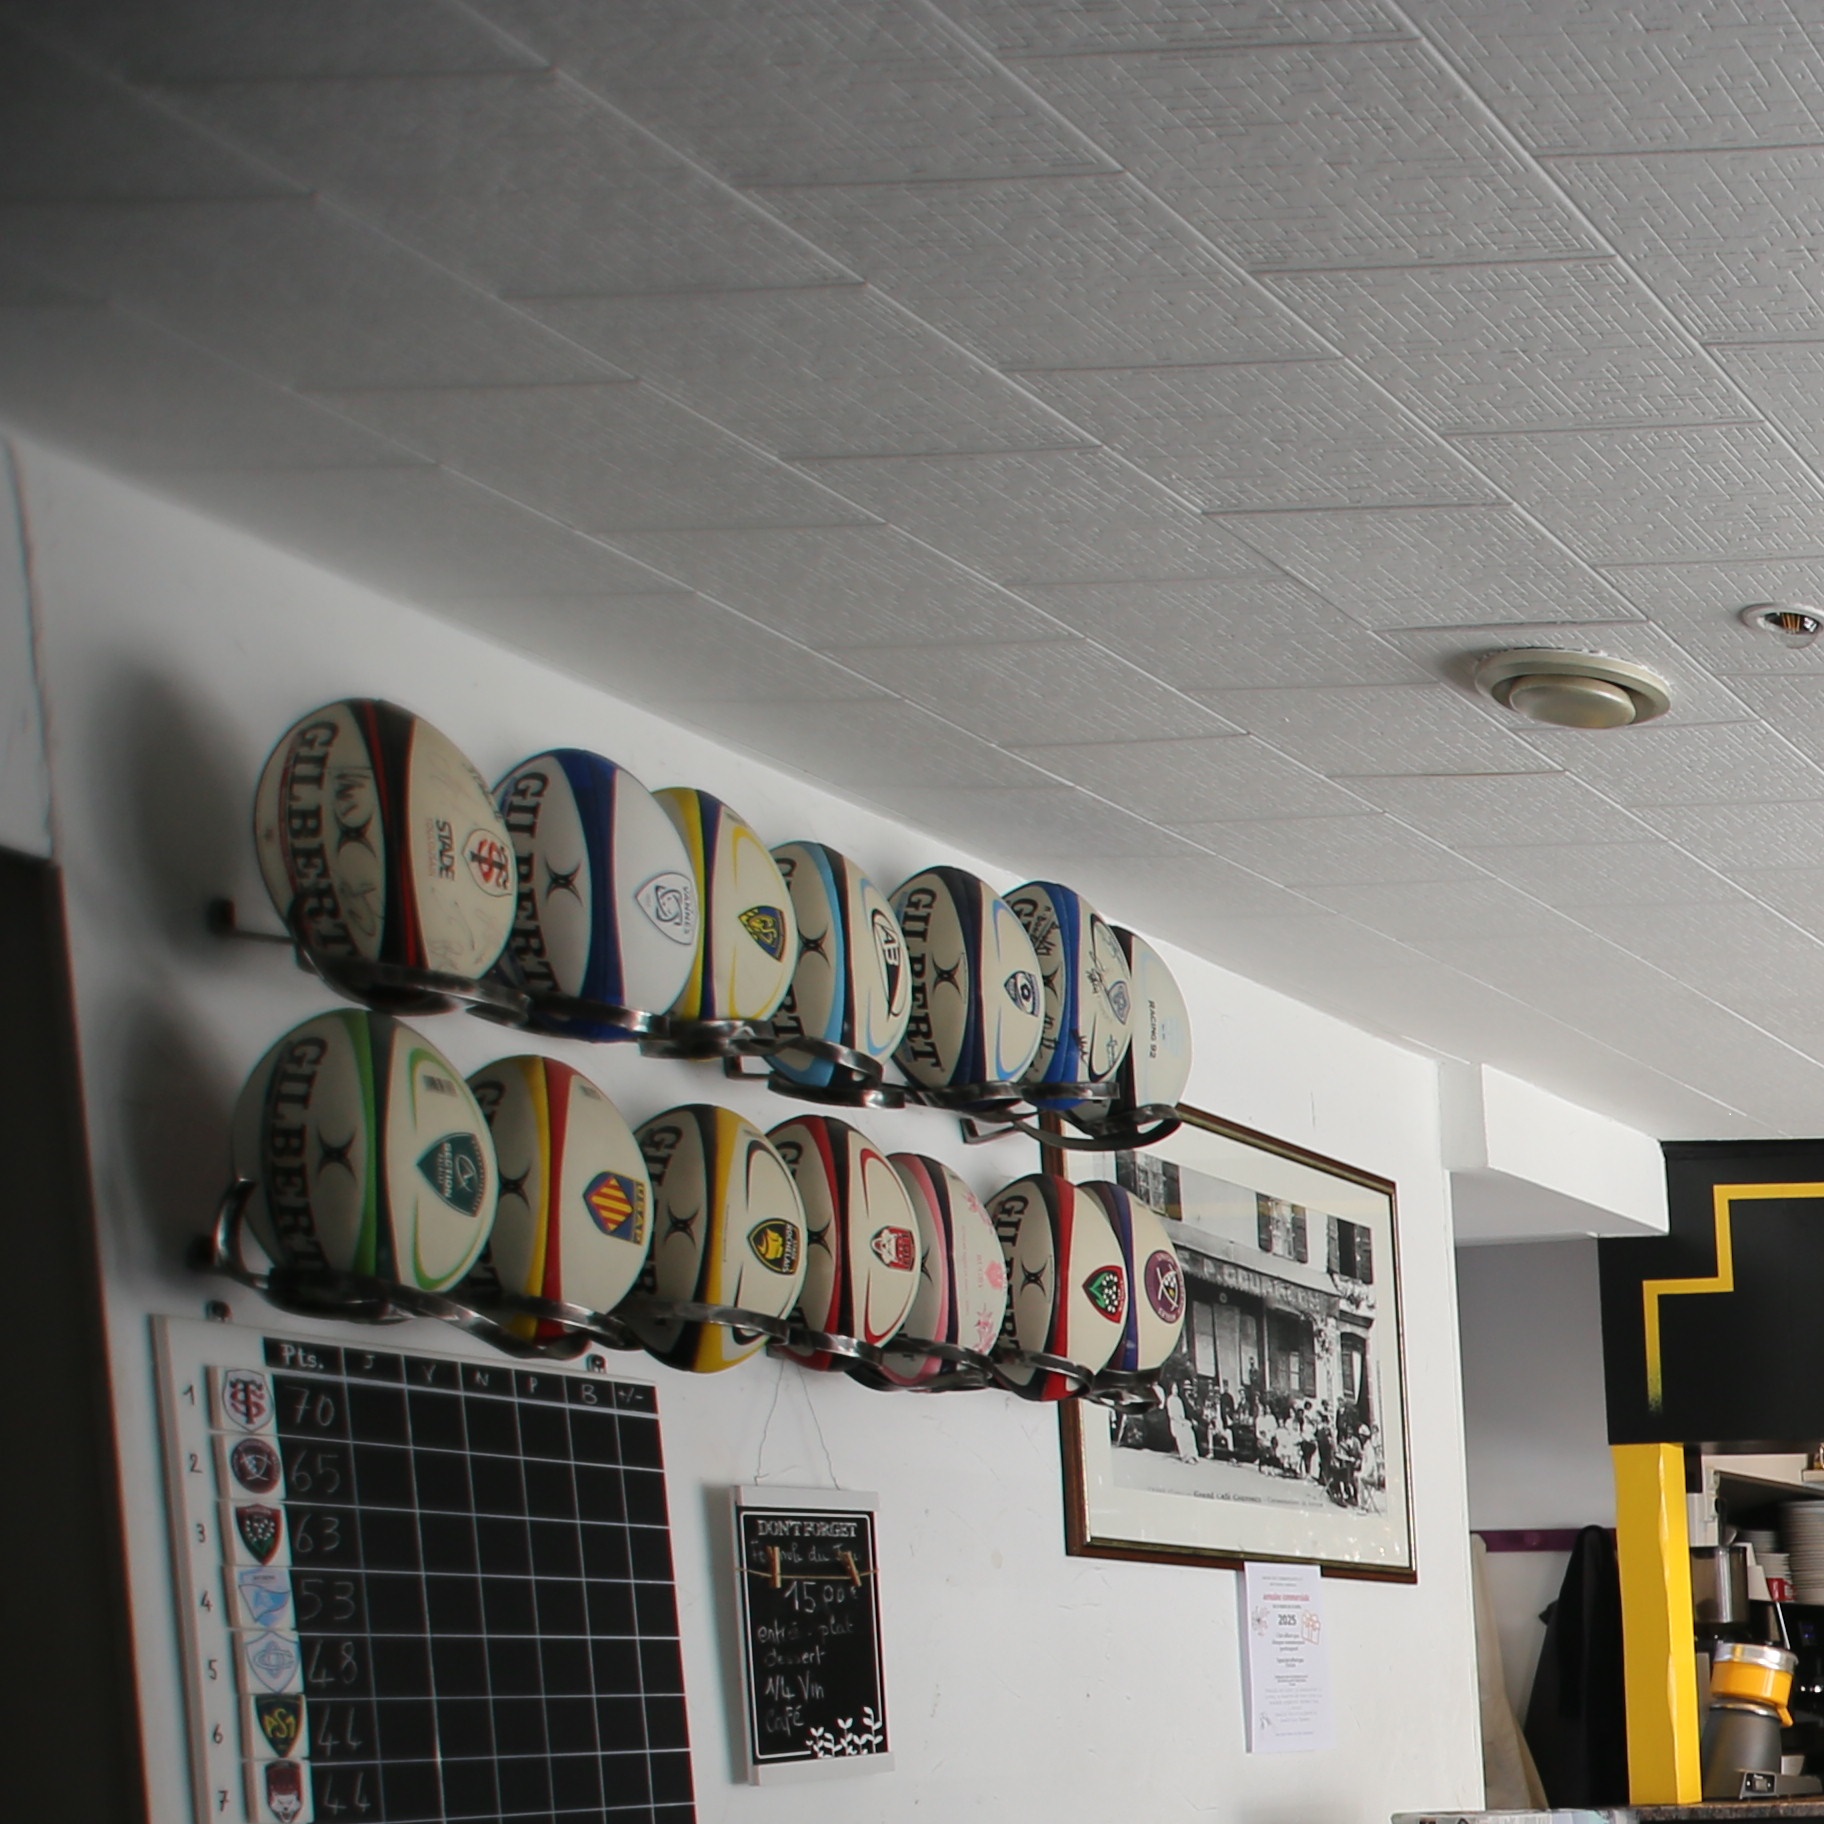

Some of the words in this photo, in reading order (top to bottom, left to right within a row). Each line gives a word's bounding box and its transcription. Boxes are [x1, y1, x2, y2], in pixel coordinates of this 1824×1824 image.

[436, 819, 456, 881] STADE
[1148, 1000, 1158, 1046] RACING
[1149, 1045, 1158, 1059] 92
[443, 1141, 454, 1198] SECTION
[281, 1343, 324, 1370] Pts.
[474, 1371, 490, 1388] N
[580, 1383, 599, 1405] B
[285, 1384, 336, 1428] 70
[188, 1453, 203, 1475] 2
[291, 1449, 341, 1494] 65
[196, 1522, 206, 1544] 3
[296, 1513, 341, 1554] 63
[757, 1519, 803, 1538] DON'T
[802, 1521, 859, 1538] FORGET
[200, 1591, 214, 1612] 4
[300, 1578, 357, 1622] 53
[783, 1580, 818, 1614] 15
[1277, 1613, 1298, 1627] 2025
[208, 1659, 218, 1681] 5
[308, 1638, 359, 1685] 48
[798, 1671, 826, 1700] Vin
[213, 1723, 224, 1745] 6
[317, 1702, 364, 1756] 44
[217, 1789, 229, 1814] 7
[323, 1771, 372, 1816] 44
